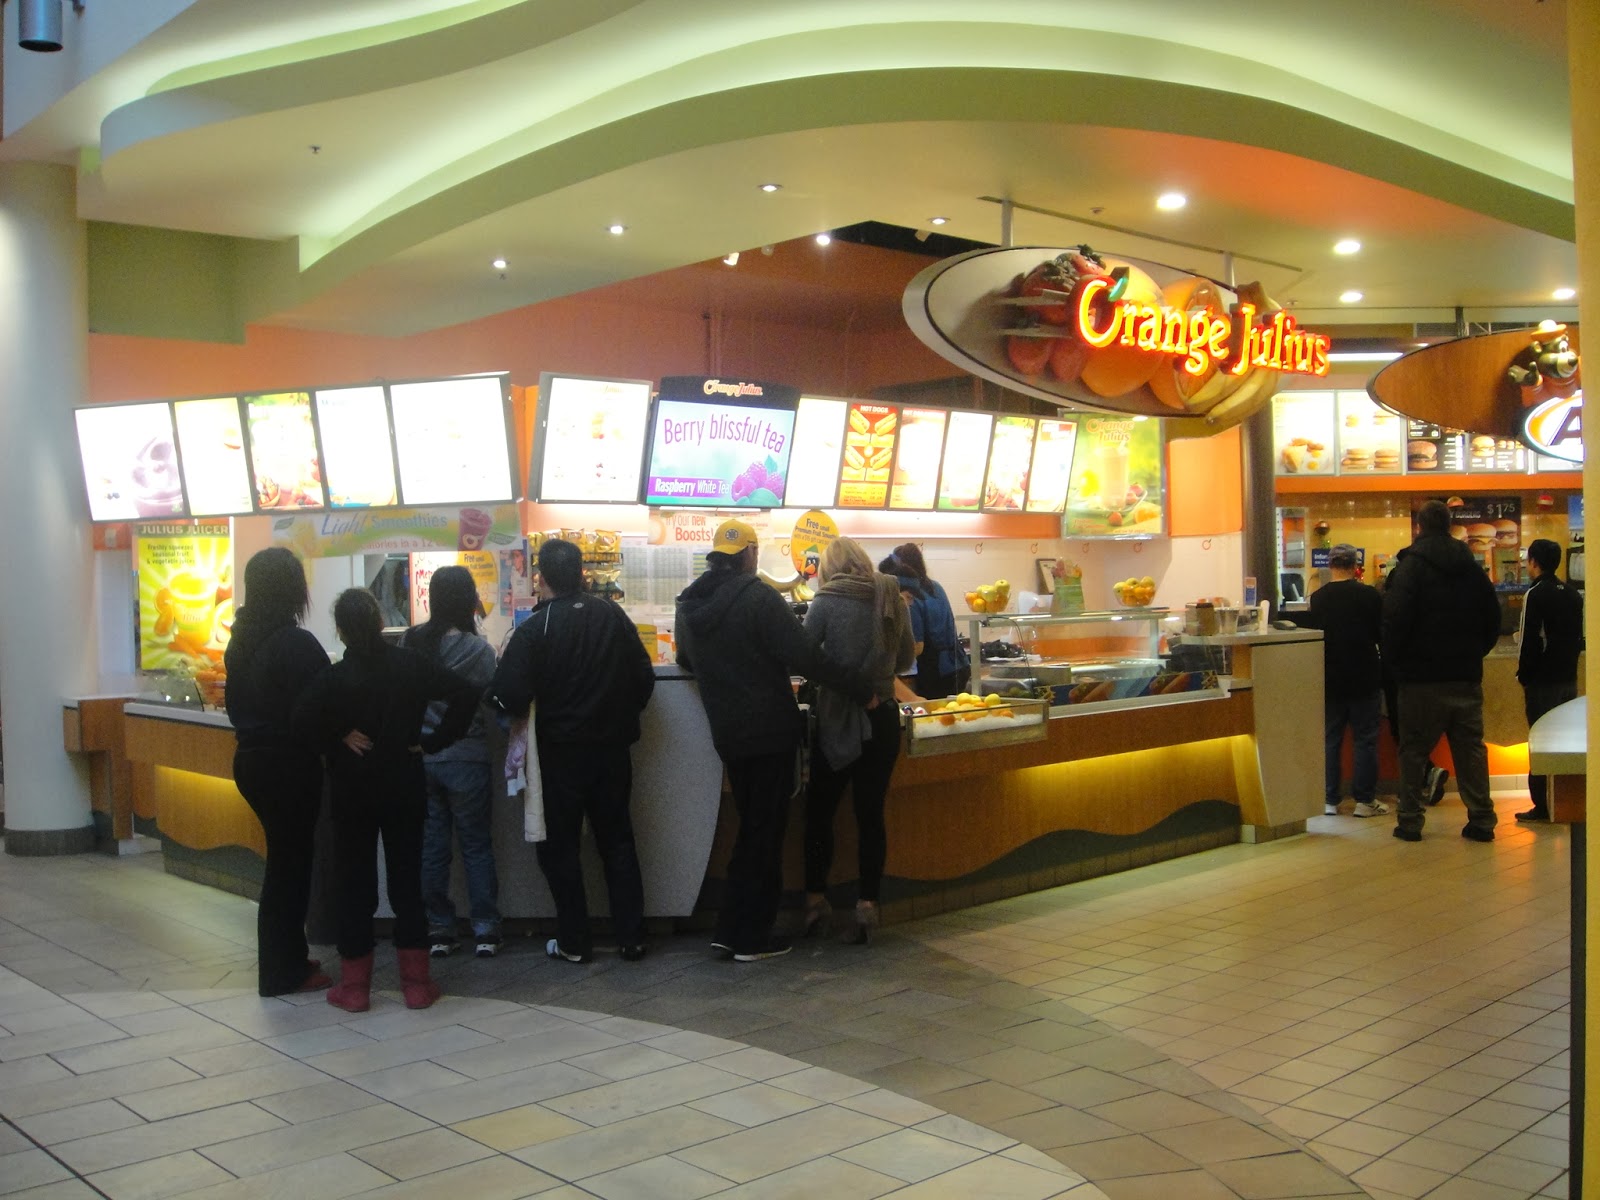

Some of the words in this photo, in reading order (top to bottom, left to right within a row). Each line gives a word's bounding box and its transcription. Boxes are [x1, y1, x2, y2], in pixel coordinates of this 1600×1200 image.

[1077, 279, 1231, 377] Orange
[1231, 302, 1331, 377] Julius
[1086, 418, 1135, 433] Orange
[664, 418, 705, 446] Berry
[709, 413, 762, 444] blissful
[762, 422, 786, 454] tea
[655, 478, 696, 496] Raspberry
[697, 480, 717, 494] White
[718, 481, 731, 494] Tea
[371, 514, 448, 529] Smoothies
[691, 515, 706, 527] new
[806, 518, 819, 529] Free
[141, 525, 183, 535] JULIUS
[187, 525, 229, 535] JUICER
[675, 526, 715, 542] Boosts!
[464, 553, 475, 563] Free
